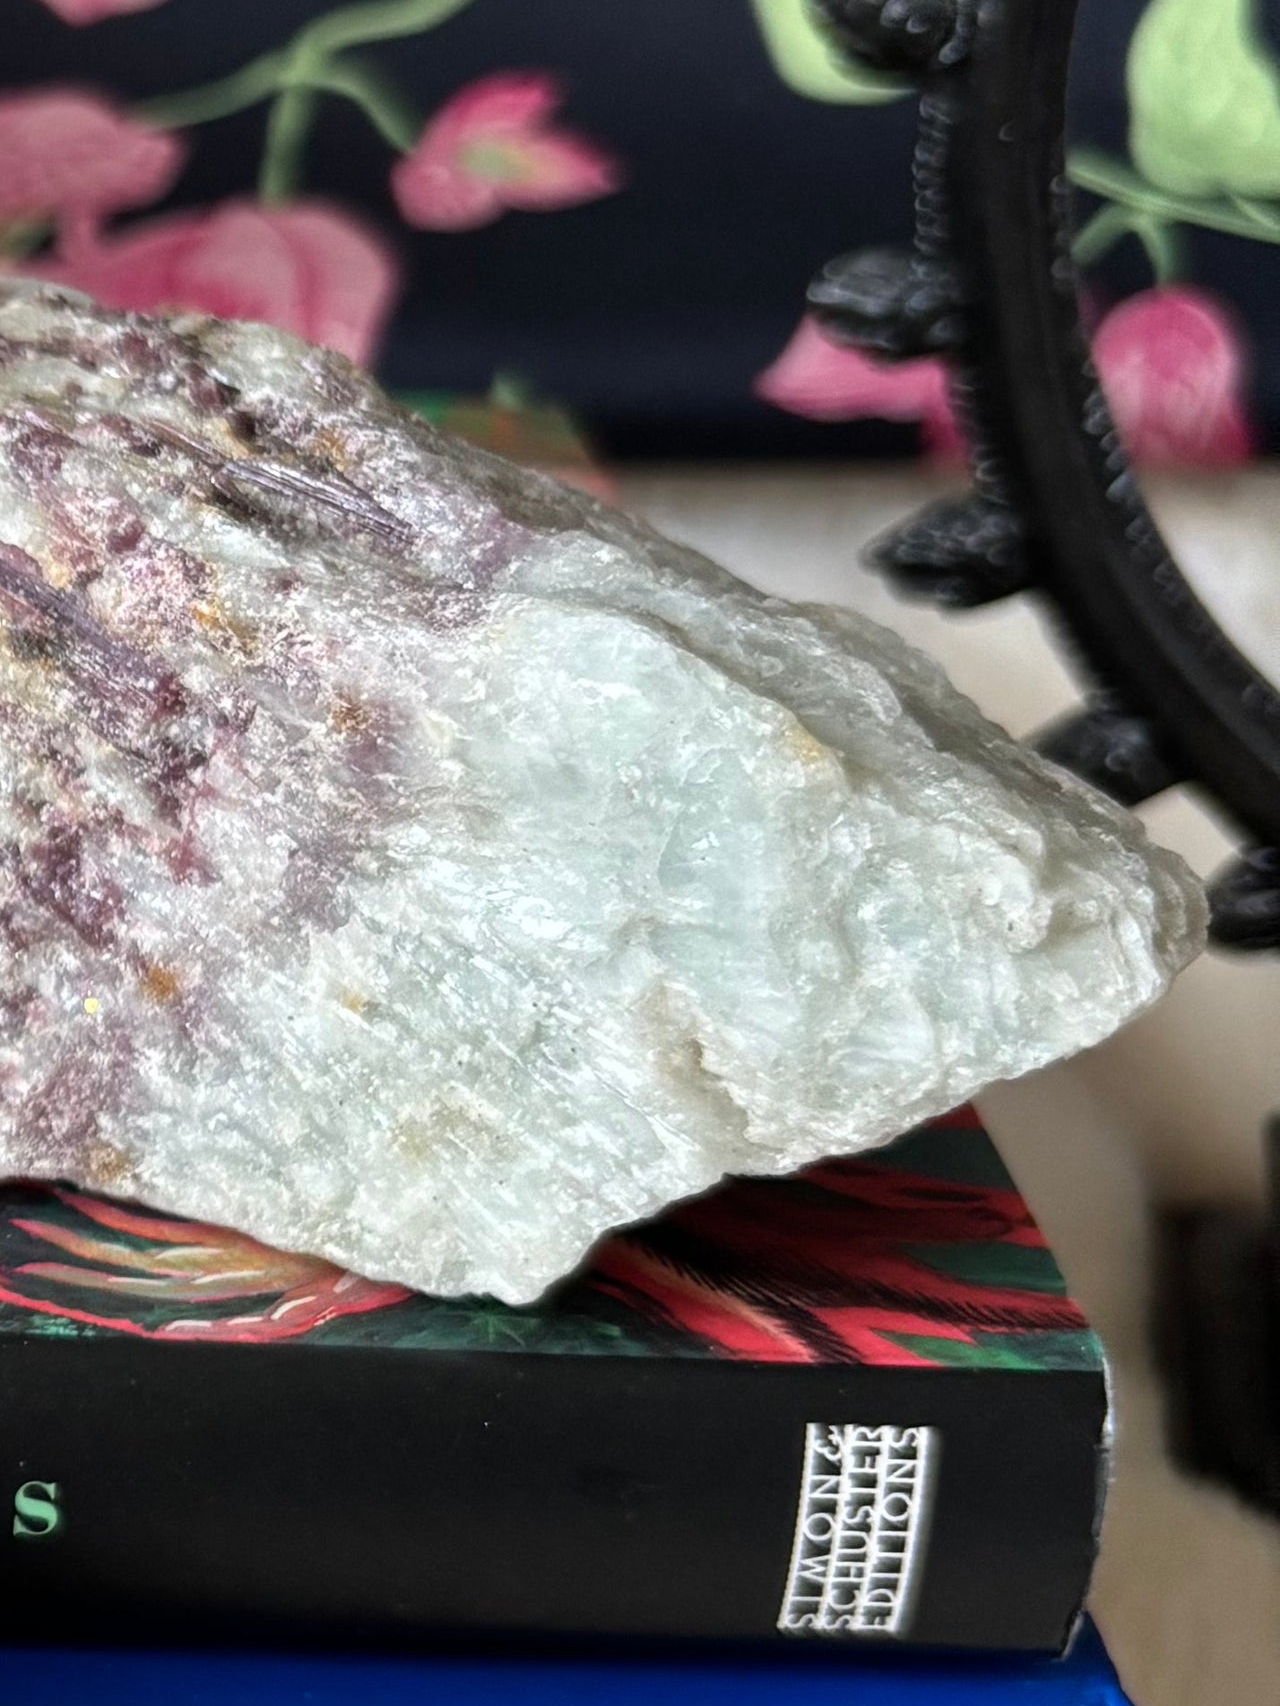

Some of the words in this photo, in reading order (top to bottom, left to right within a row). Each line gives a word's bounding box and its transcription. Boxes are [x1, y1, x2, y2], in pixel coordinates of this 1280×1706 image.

[785, 1474, 842, 1630] SIMON
[822, 1426, 886, 1630] SCHUSTER
[858, 1426, 924, 1630] EDITIONS
